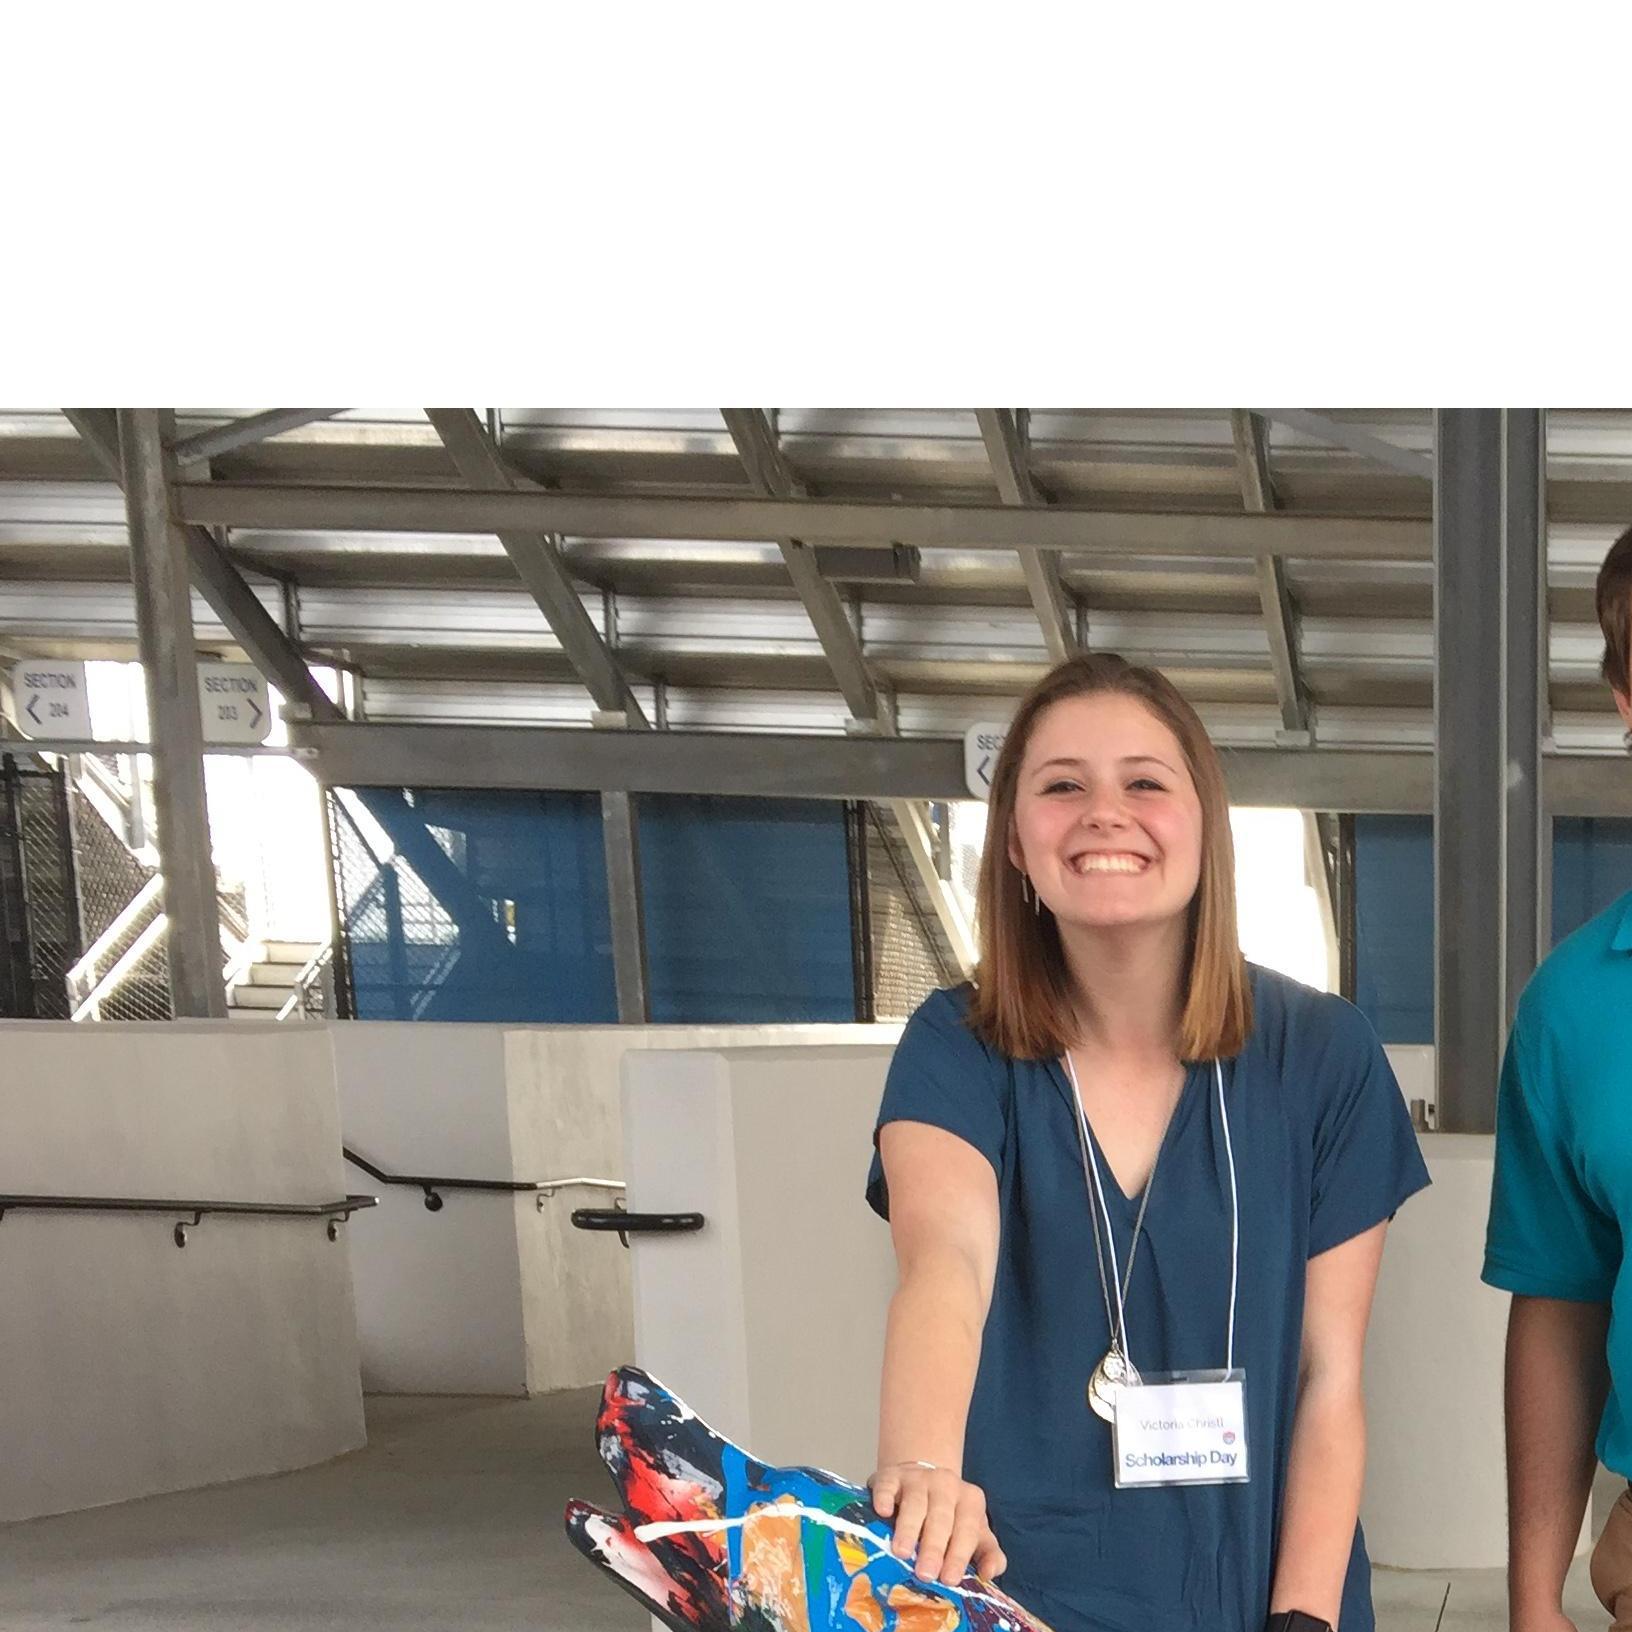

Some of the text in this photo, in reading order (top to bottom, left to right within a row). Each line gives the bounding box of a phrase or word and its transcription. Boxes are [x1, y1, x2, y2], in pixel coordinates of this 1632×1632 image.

[24, 673, 76, 689] SECTION
[205, 677, 258, 693] SECTION
[977, 735, 1006, 750] SEC
[1126, 1450, 1238, 1468] Scholarship Day
